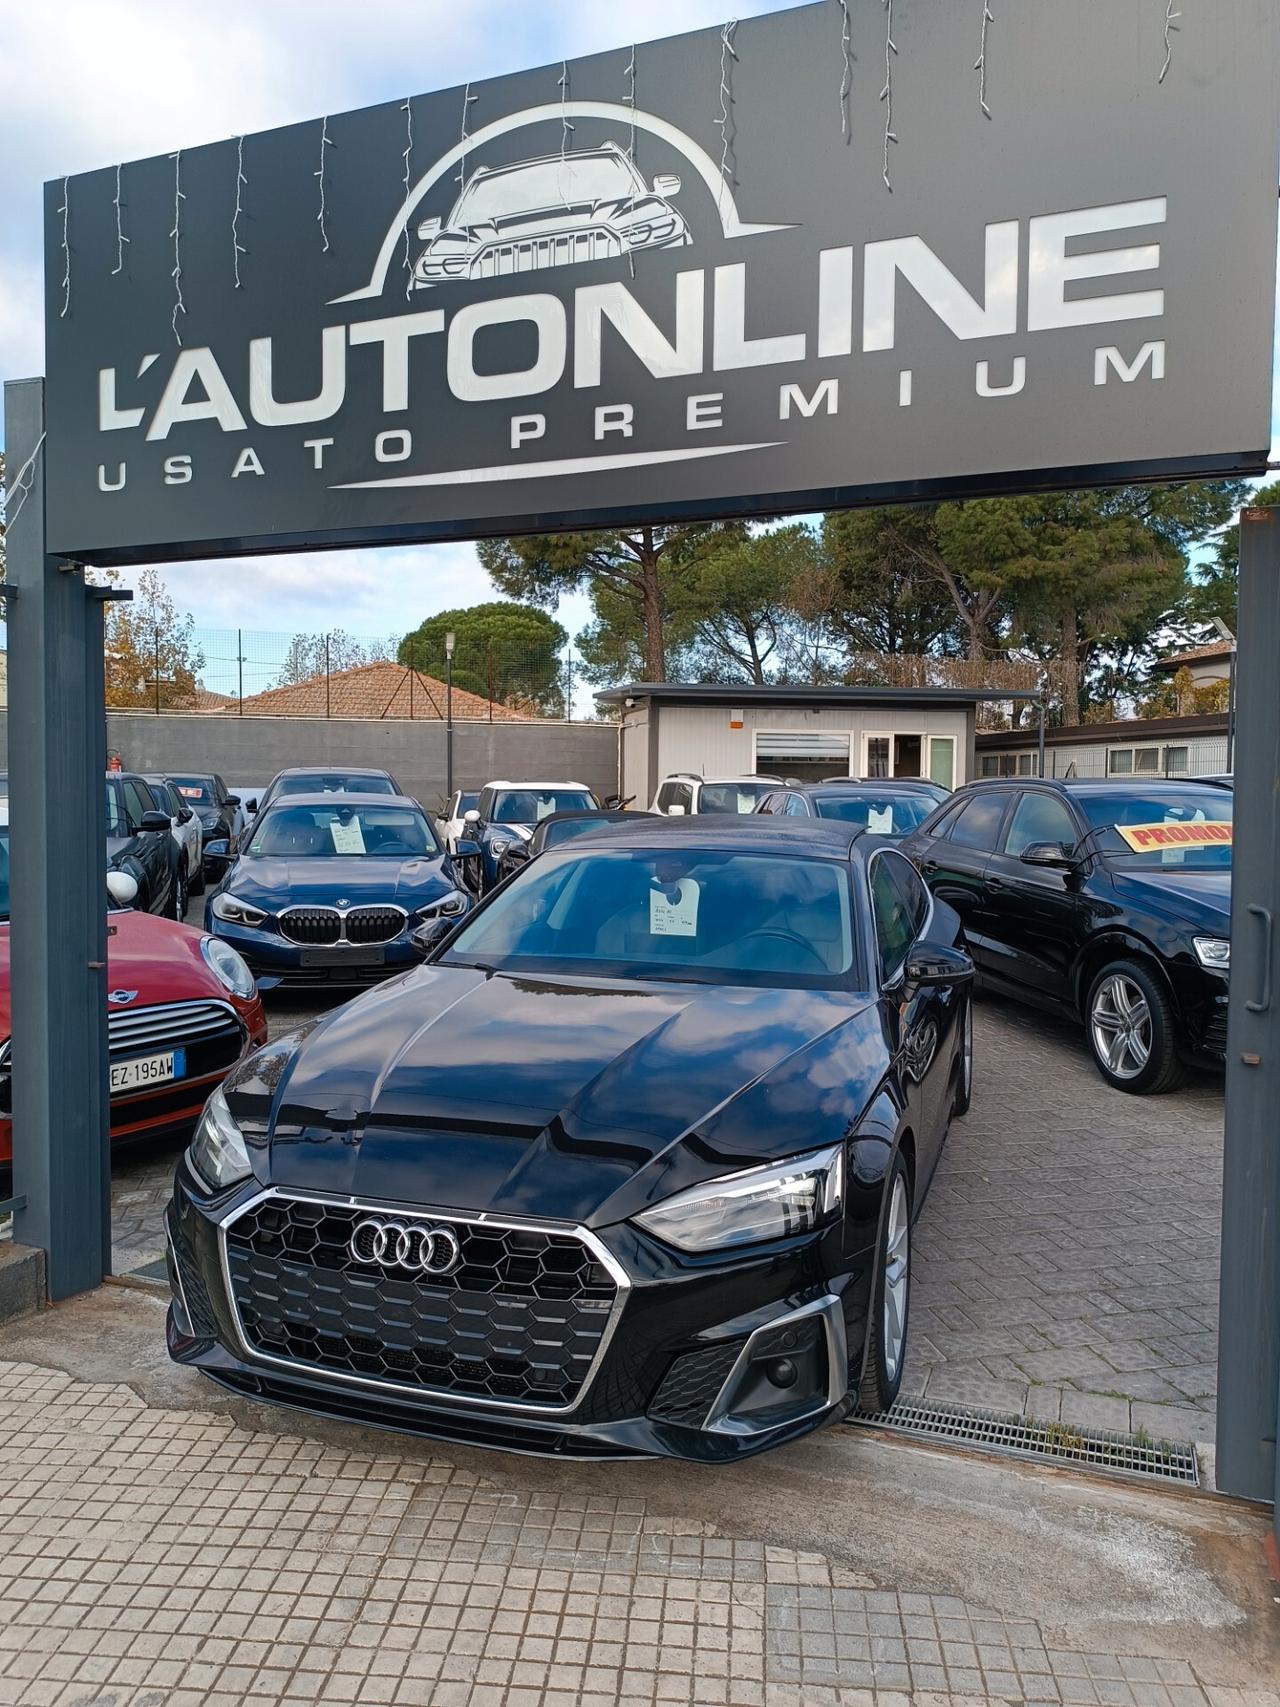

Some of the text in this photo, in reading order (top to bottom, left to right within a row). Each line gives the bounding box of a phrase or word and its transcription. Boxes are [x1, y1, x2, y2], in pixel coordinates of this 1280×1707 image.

[98, 340, 1166, 493] USATO PREMIUM
[99, 197, 1168, 442] L'AUTONLINE
